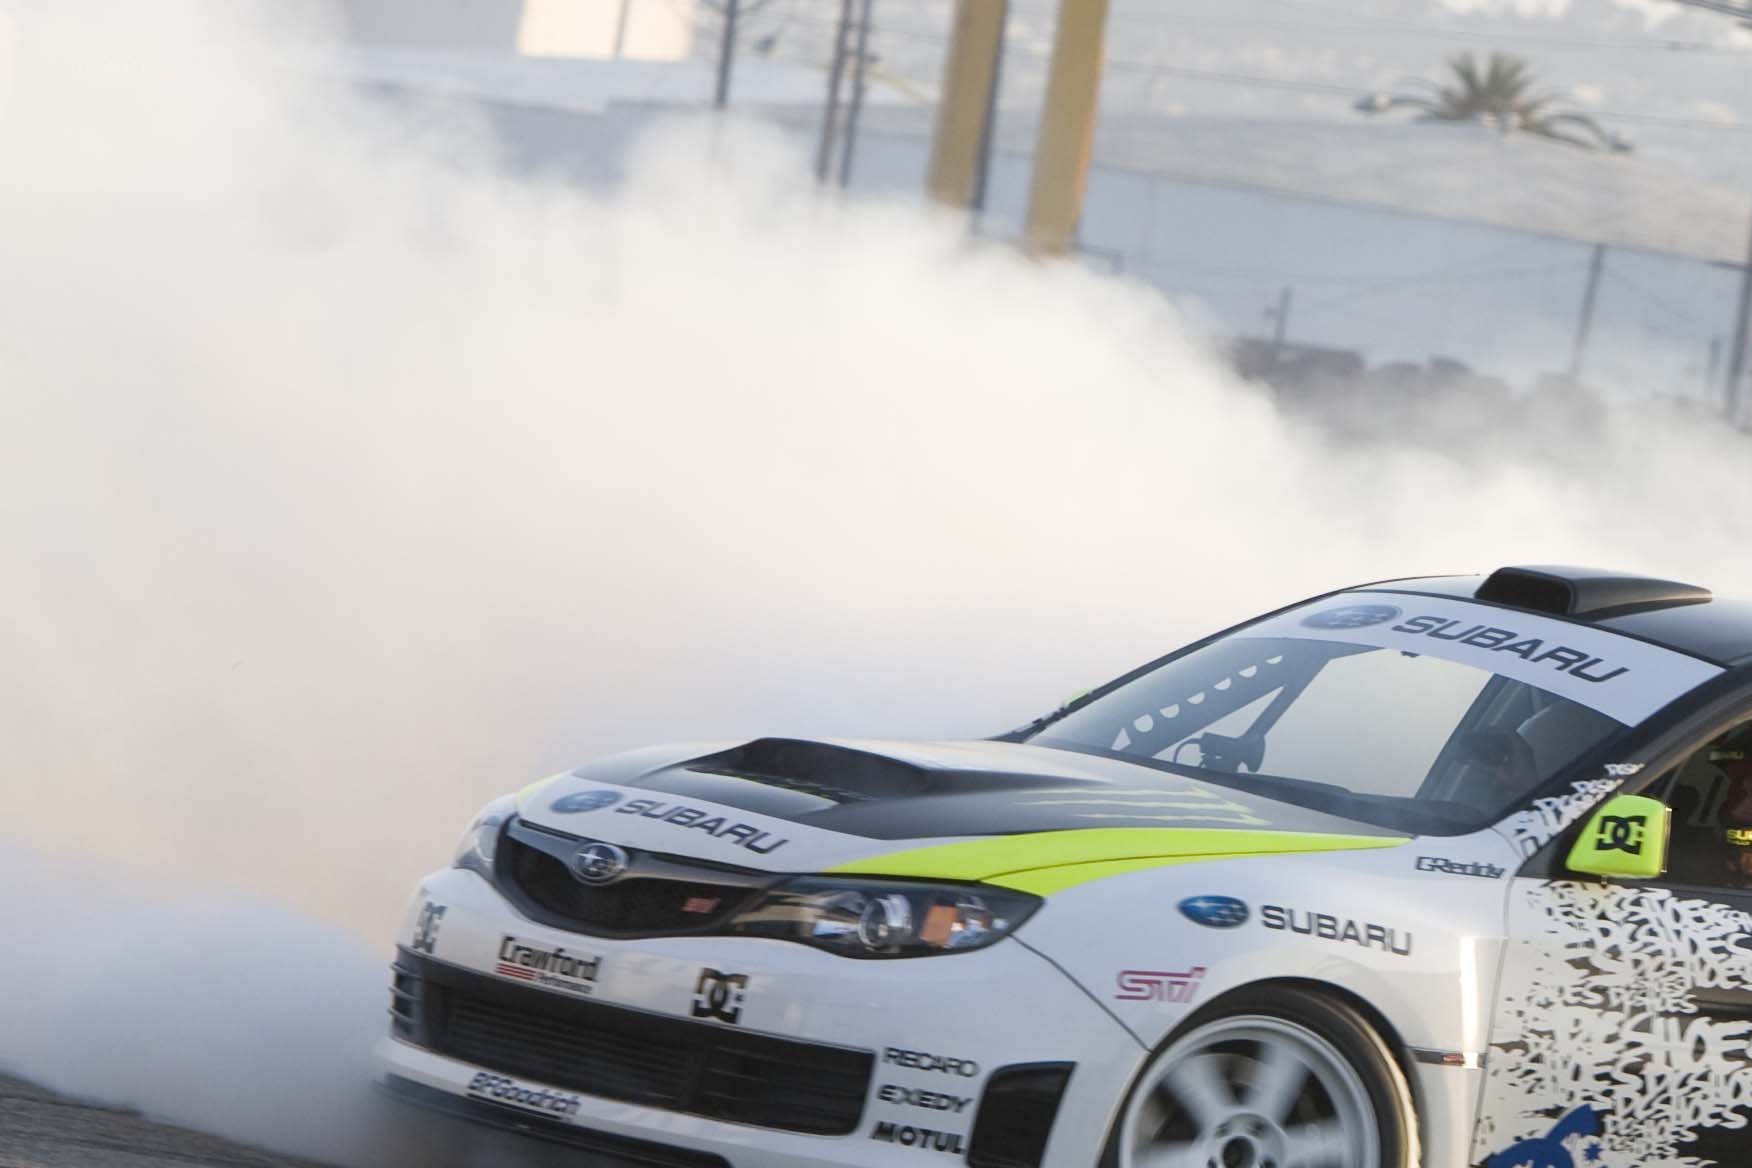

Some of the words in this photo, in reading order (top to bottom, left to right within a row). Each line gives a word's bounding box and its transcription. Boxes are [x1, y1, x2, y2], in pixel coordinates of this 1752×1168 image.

[1392, 615, 1630, 684] SUBARU
[614, 799, 791, 855] SUBARU
[1259, 904, 1413, 957] SUBARU
[498, 935, 604, 982] Crawford
[883, 1046, 979, 1078] RECARO
[877, 1083, 975, 1114] EXEDY
[870, 1120, 968, 1155] MOTUL
